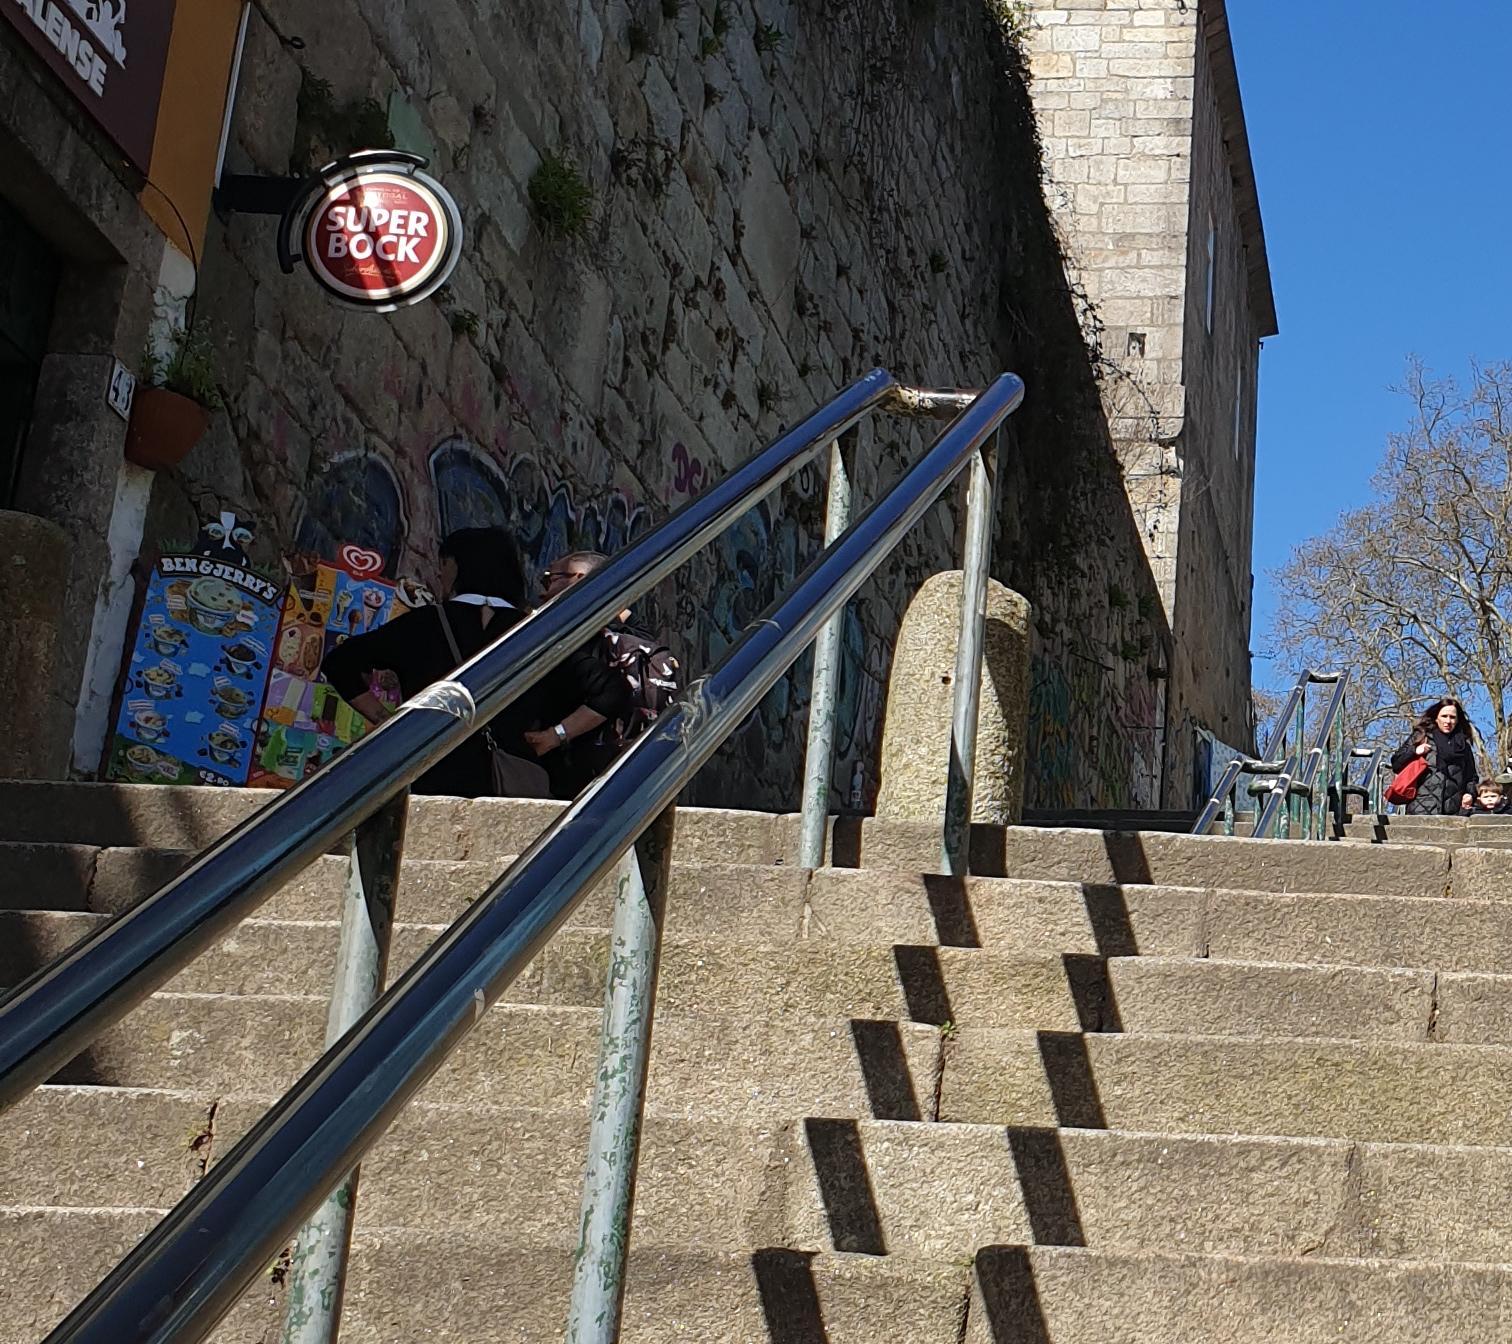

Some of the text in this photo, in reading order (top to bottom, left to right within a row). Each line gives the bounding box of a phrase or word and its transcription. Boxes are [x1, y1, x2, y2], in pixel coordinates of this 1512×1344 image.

[326, 206, 430, 237] SUPER
[328, 232, 421, 264] BOCK
[161, 557, 198, 573] BEN
[213, 563, 278, 600] JERRY'S
